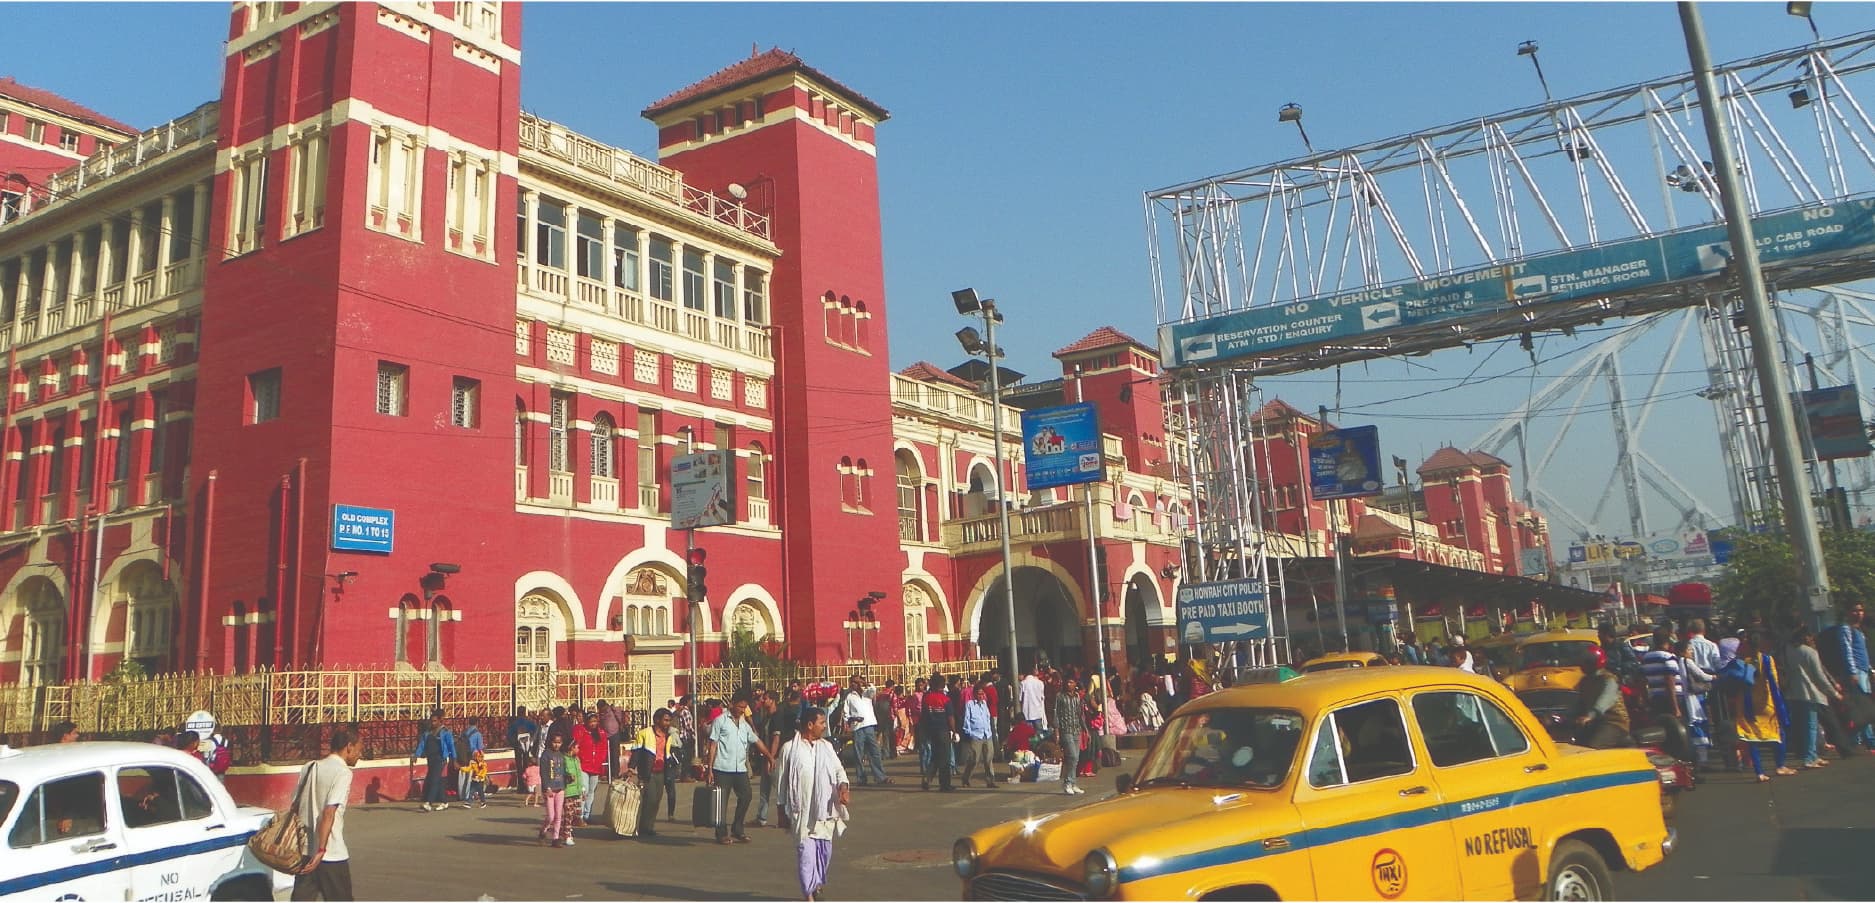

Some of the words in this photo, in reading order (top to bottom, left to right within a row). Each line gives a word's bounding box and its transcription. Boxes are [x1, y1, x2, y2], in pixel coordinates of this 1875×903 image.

[1803, 207, 1835, 221] NO
[1775, 231, 1803, 243] CAB
[1806, 224, 1844, 238] ROAD
[1550, 272, 1581, 285] STN.
[1582, 259, 1648, 279] MANAGER
[1612, 268, 1650, 283] ROOM
[1284, 302, 1309, 316] NO
[1330, 286, 1403, 307] VEHICLE
[1217, 324, 1289, 342] RESERVATION
[1291, 314, 1342, 329] COUNTER
[1226, 340, 1250, 351] ATM
[1256, 334, 1278, 344] STD
[1285, 324, 1333, 339] ENQUIRY
[341, 513, 355, 522] OLD
[356, 515, 389, 526] COMPLEX
[371, 526, 380, 538] TO
[1222, 583, 1239, 597] CITY
[1240, 582, 1262, 595] POLICE
[1181, 606, 1198, 620] PRE
[1198, 604, 1216, 618] PAID
[1217, 601, 1236, 617] TAXI
[1237, 600, 1265, 614] BOOTH
[1464, 836, 1483, 857] NO
[1483, 826, 1538, 856] REFUSAL
[160, 872, 180, 887] NO
